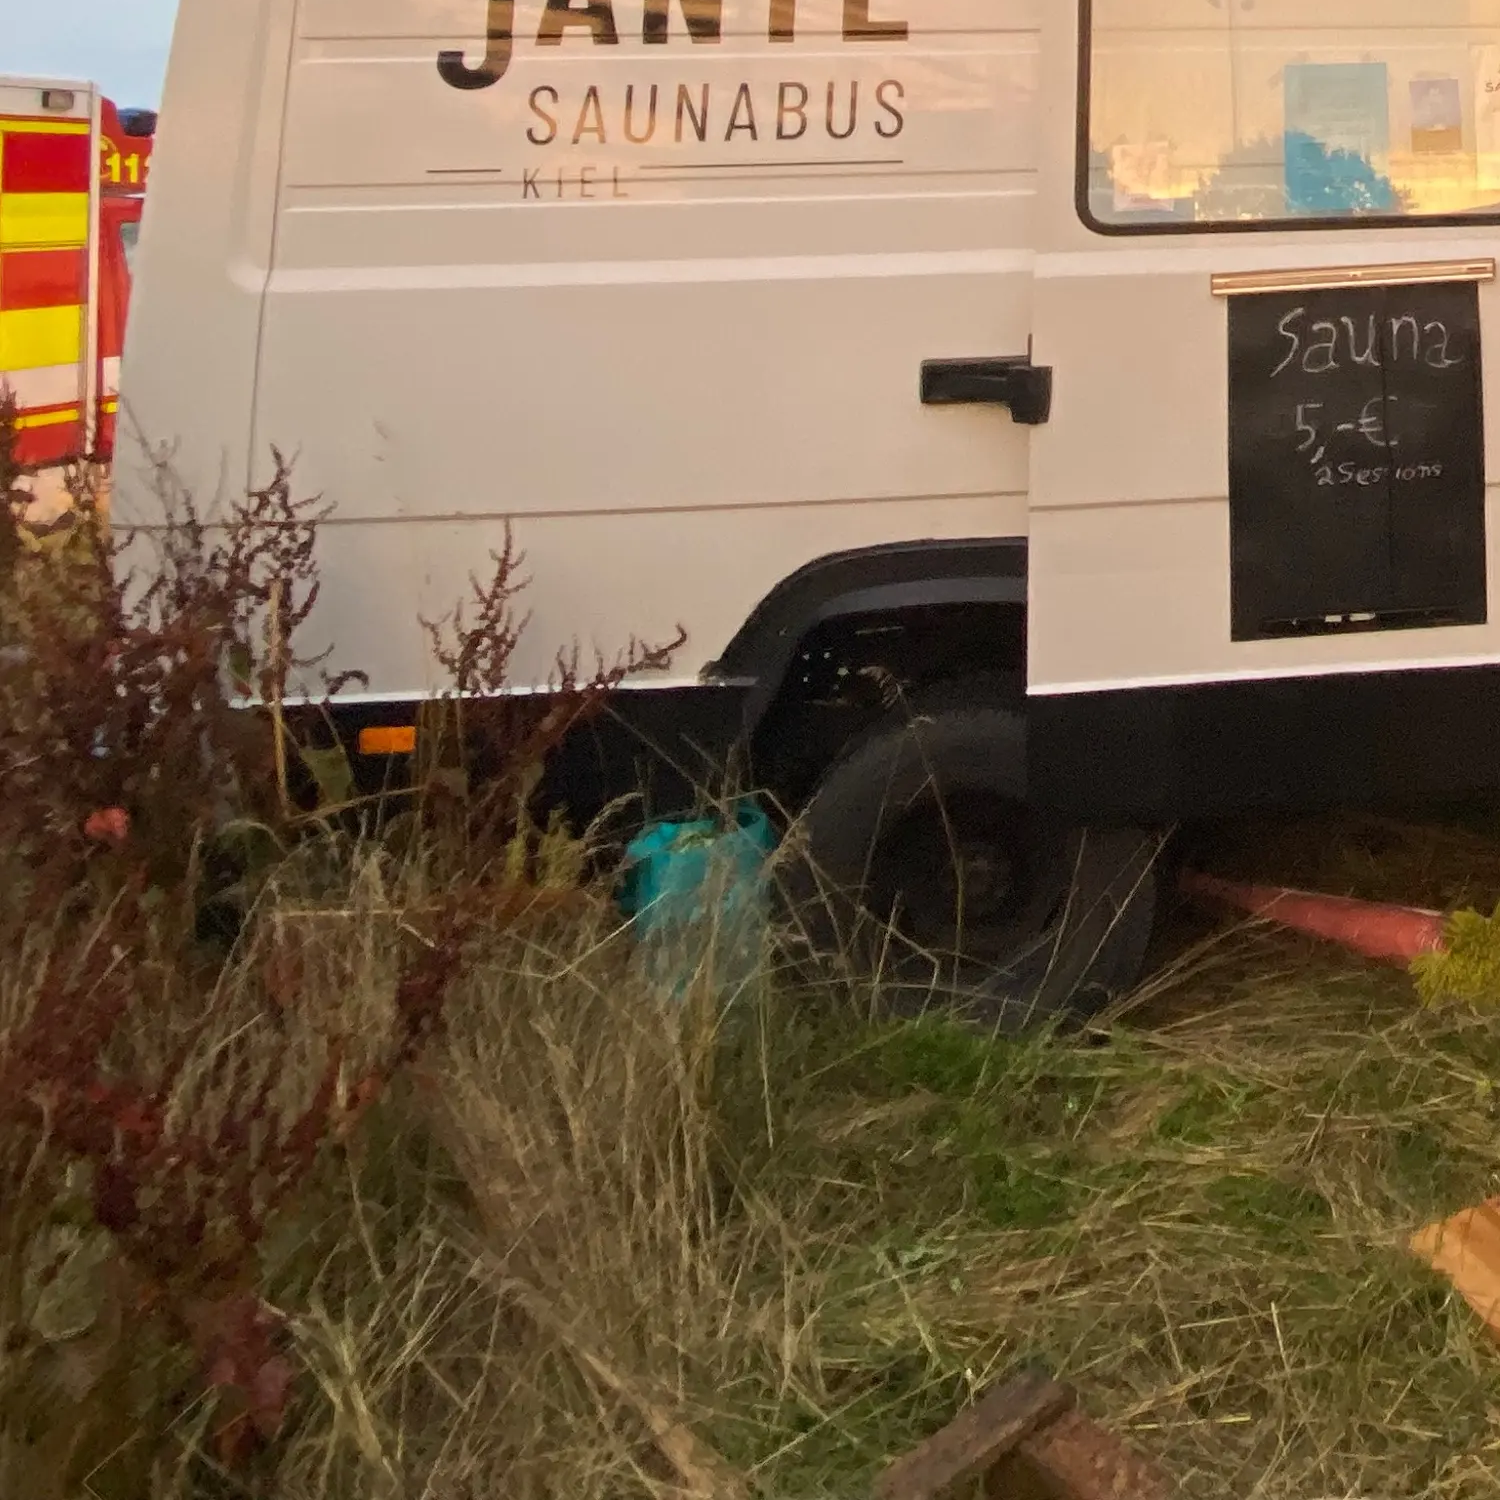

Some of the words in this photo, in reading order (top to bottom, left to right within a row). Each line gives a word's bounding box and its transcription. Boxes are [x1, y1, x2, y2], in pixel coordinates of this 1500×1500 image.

[525, 79, 906, 147] SAUNABUS
[521, 165, 630, 200] KIEL
[1269, 306, 1464, 378] Sauna
